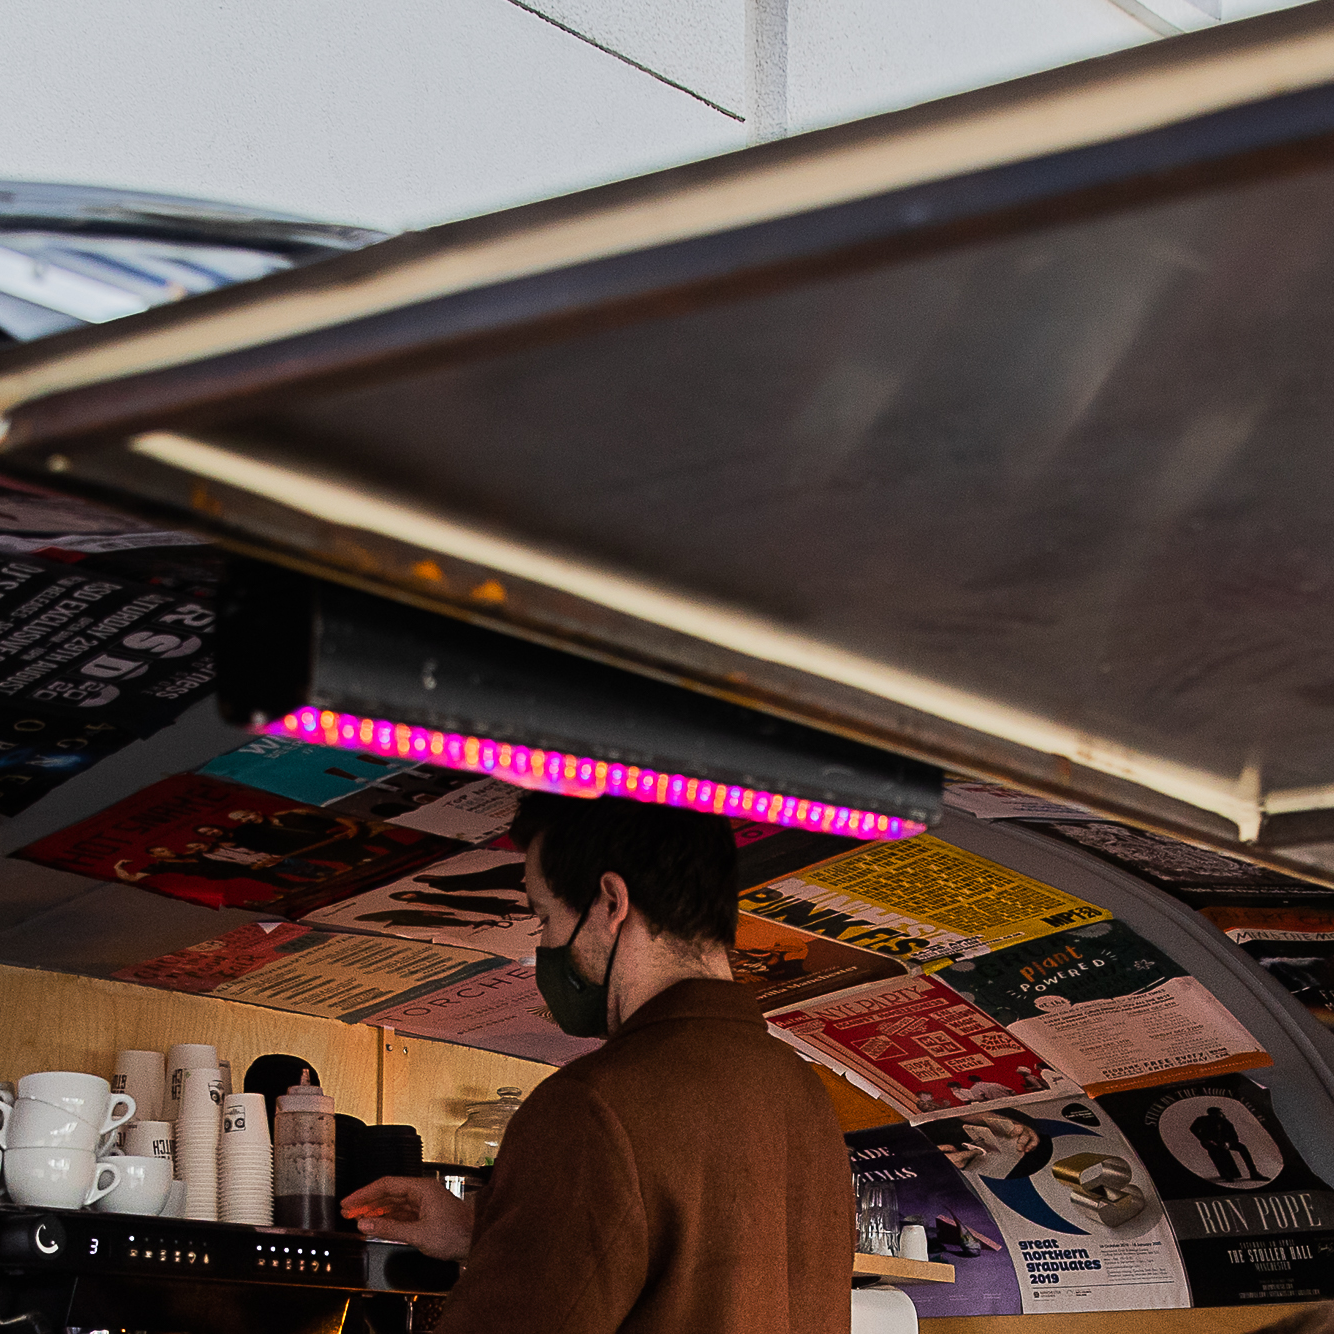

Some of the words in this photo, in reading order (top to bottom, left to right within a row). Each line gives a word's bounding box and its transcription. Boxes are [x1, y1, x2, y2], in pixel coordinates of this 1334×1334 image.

[0, 599, 88, 656] EXCLUSIVE
[53, 636, 99, 664] 29TH
[1019, 958, 1106, 993] POWERED
[815, 1003, 855, 1021] NYE
[857, 986, 928, 1012] PARTY
[1195, 1199, 1250, 1235] RON
[1253, 1193, 1322, 1231] POPE
[1019, 1238, 1059, 1250] great
[1227, 1249, 1245, 1264] THE
[1291, 1245, 1314, 1260] HALL
[1030, 1273, 1060, 1285] 2019
